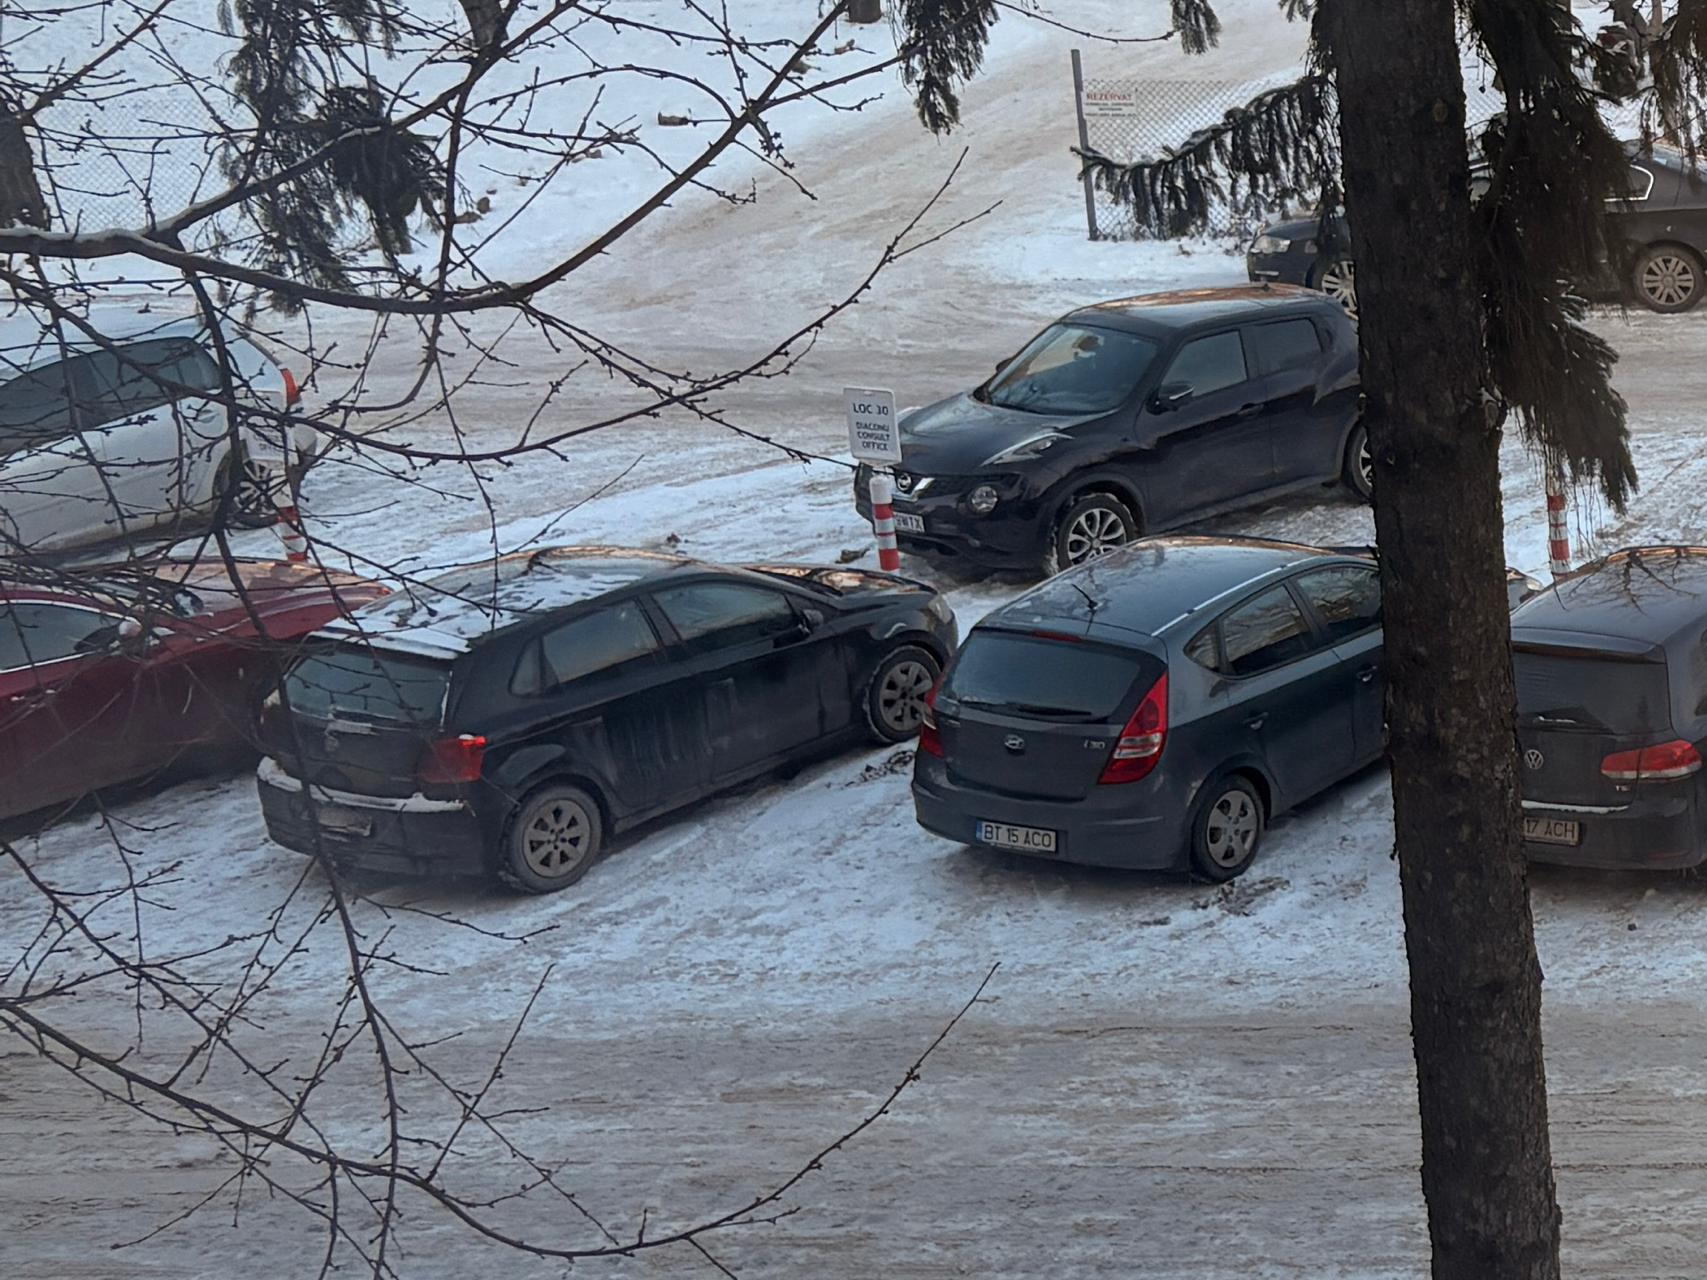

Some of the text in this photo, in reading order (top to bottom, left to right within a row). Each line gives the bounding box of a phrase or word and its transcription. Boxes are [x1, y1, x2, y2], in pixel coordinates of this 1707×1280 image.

[853, 403, 873, 414] LOC
[984, 824, 1053, 848] BT 15 ACO
[1543, 821, 1576, 838] ACH
